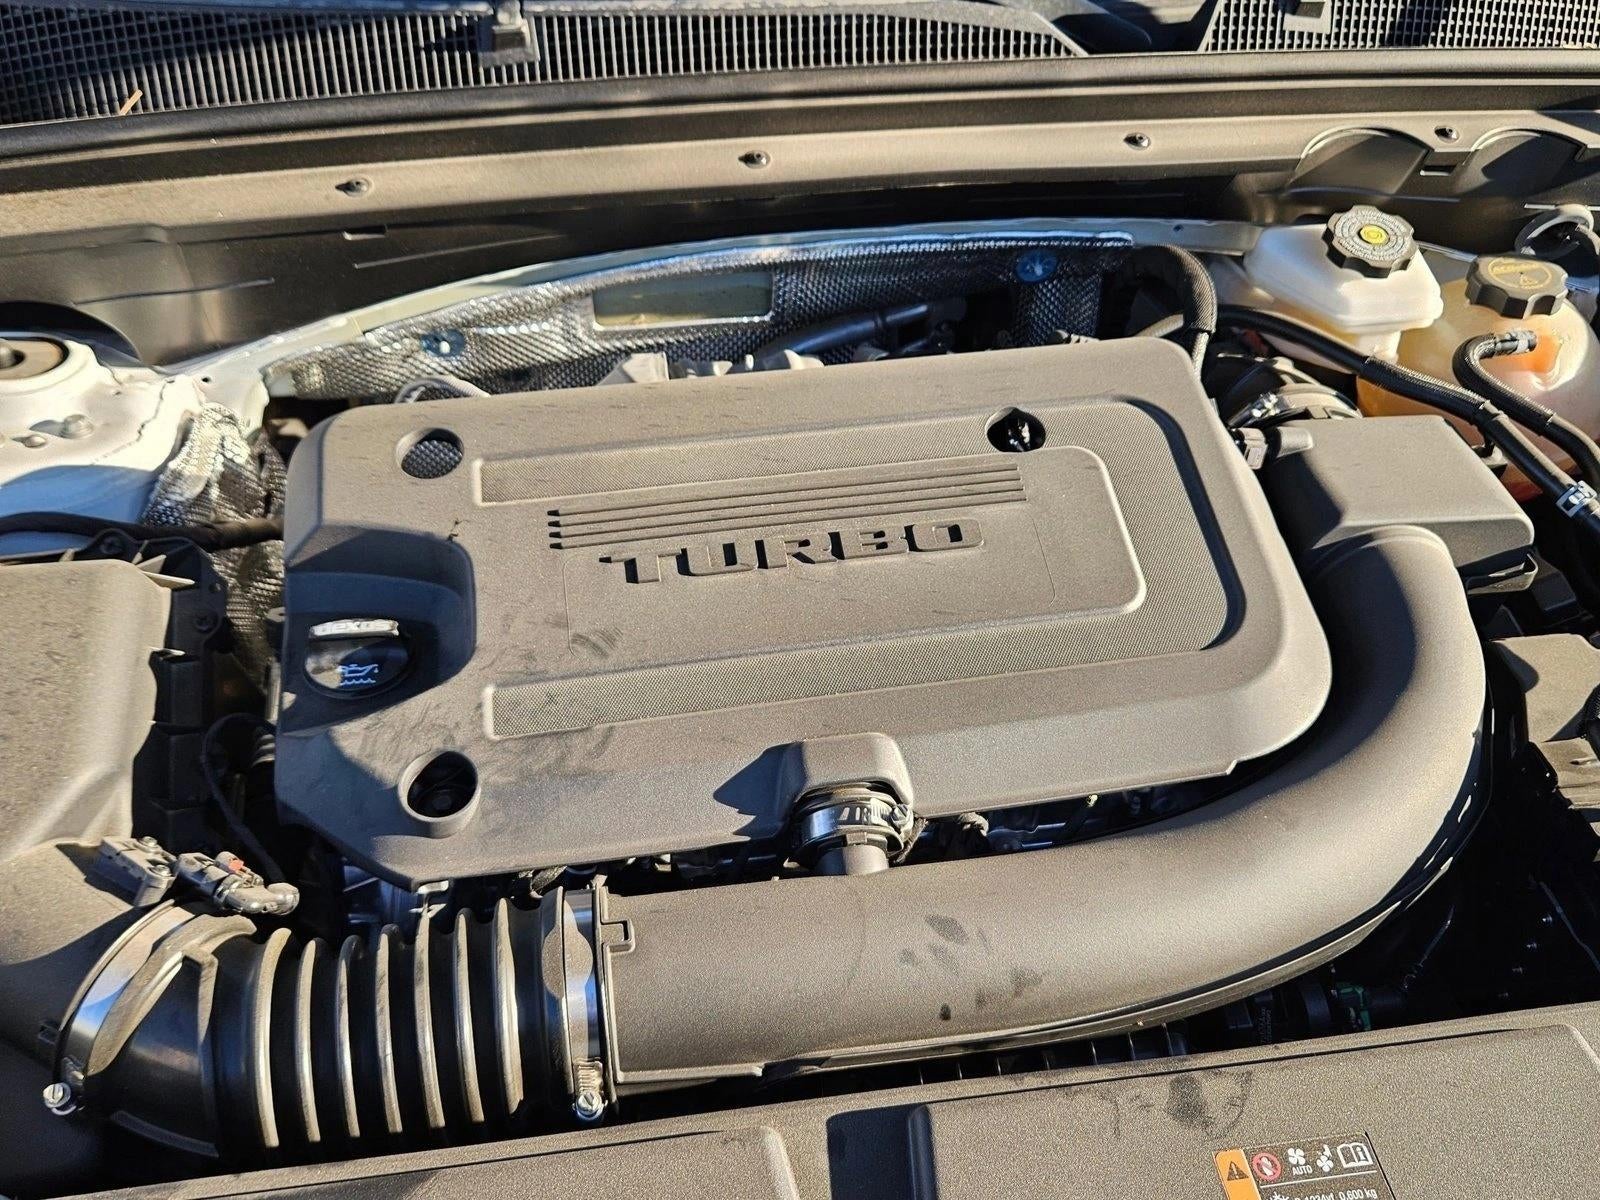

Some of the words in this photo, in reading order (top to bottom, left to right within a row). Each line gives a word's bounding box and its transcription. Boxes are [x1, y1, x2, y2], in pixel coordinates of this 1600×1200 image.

[599, 519, 984, 584] TURBO
[1292, 1165, 1313, 1176] AUTO
[1363, 1187, 1378, 1199] kg
